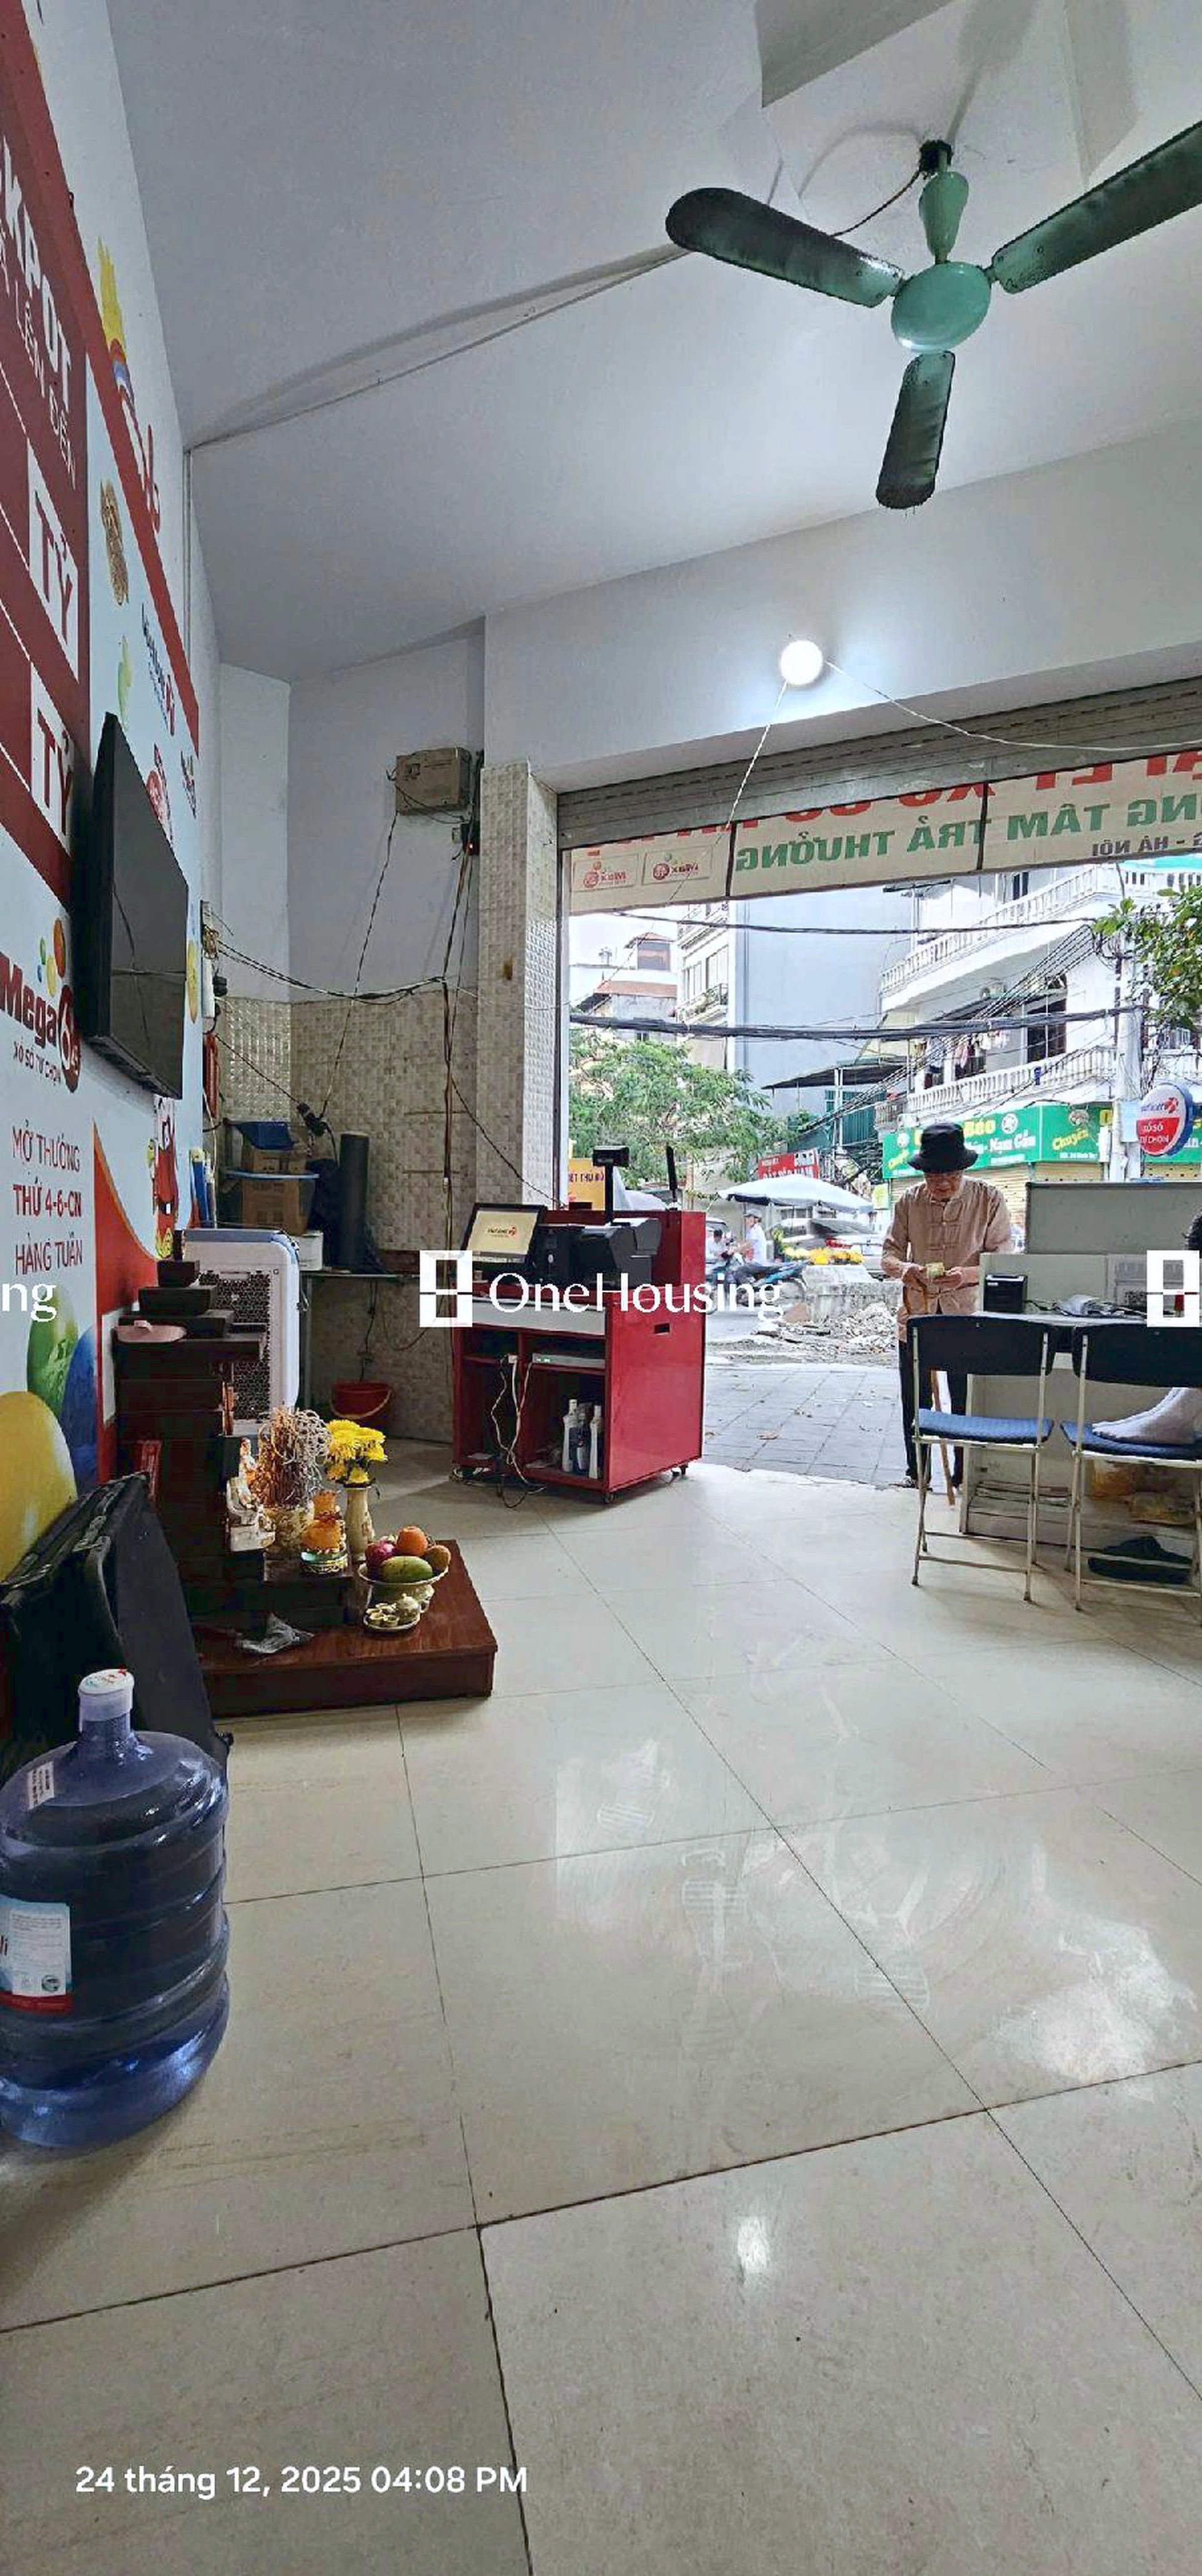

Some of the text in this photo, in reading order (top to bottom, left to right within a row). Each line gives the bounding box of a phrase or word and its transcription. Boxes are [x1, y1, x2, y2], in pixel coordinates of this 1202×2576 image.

[0, 135, 71, 413] KPOT
[34, 490, 73, 644] TỶ
[38, 707, 73, 837] TỶ
[0, 951, 57, 1049] Mega
[13, 1119, 32, 1162] MỞ
[13, 1176, 42, 1216] THỨ
[16, 1231, 83, 1275] HÀNG TUẦN
